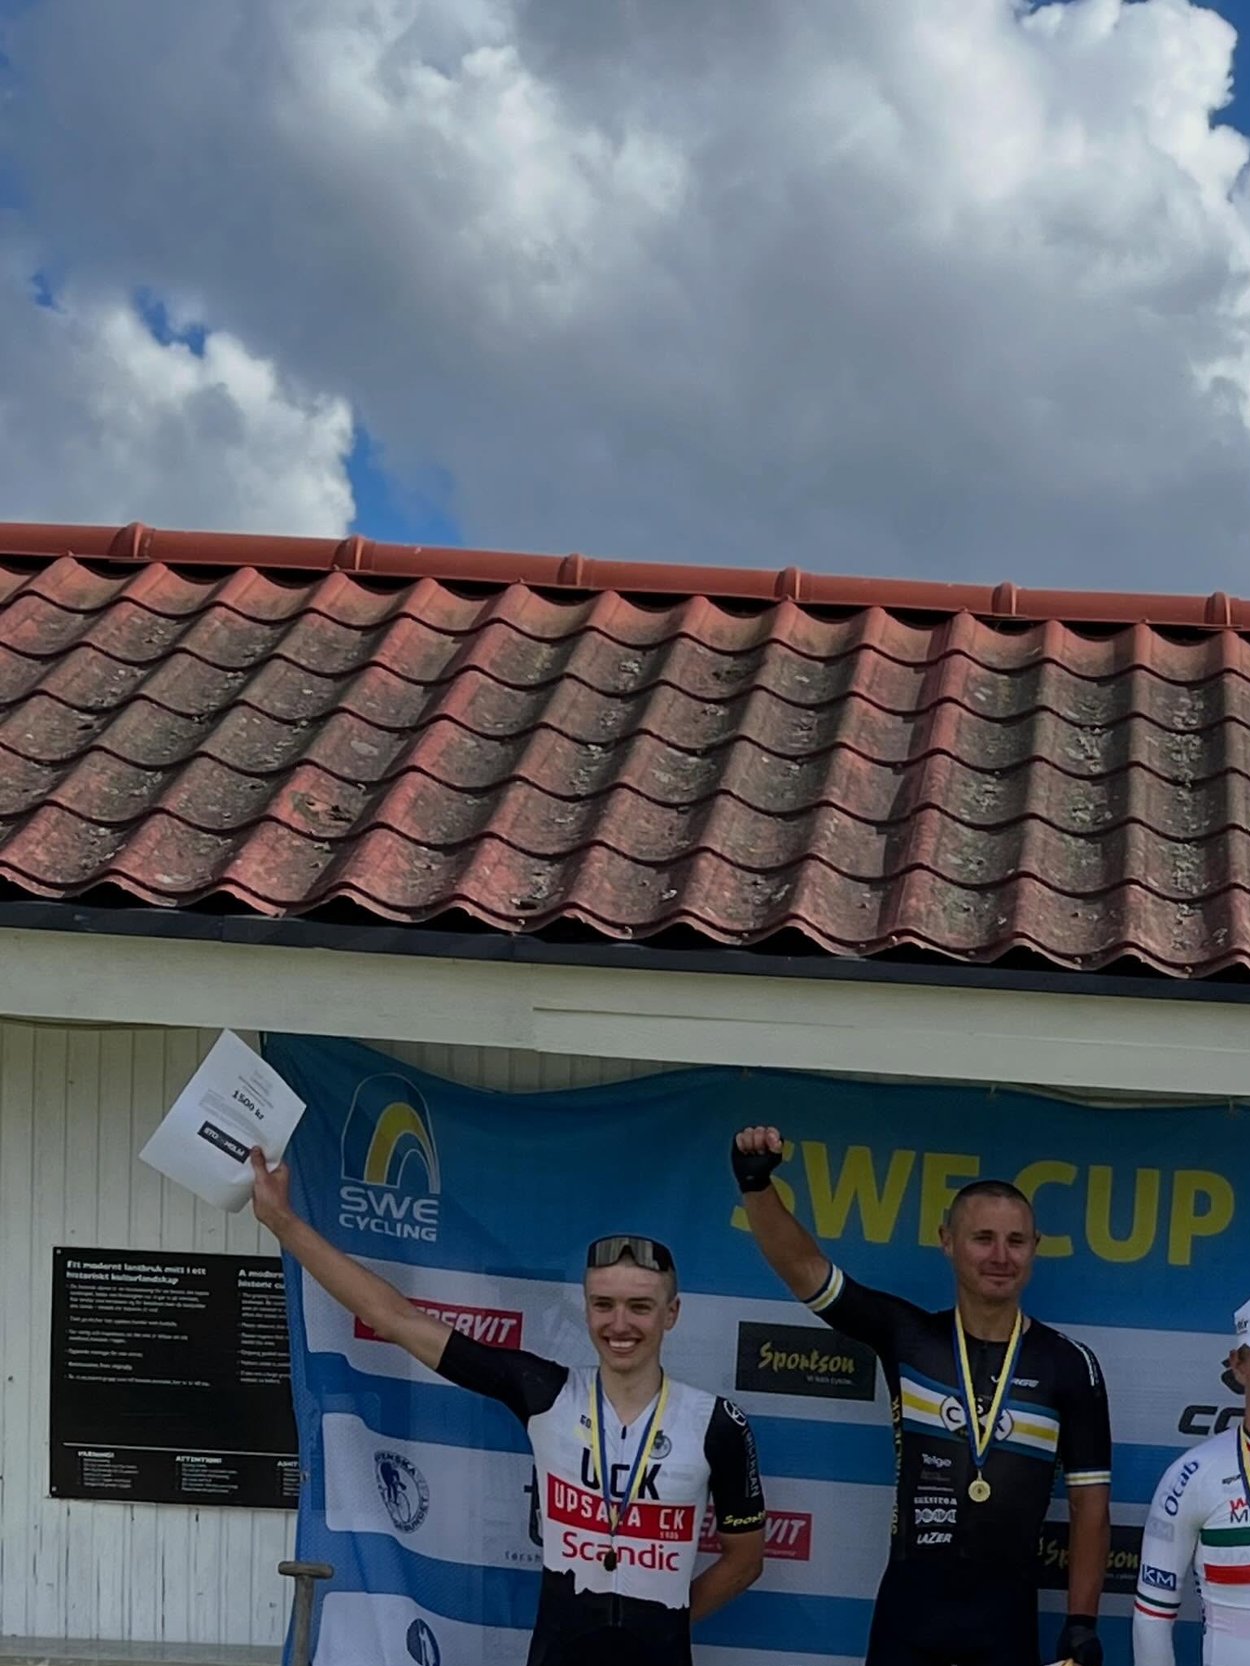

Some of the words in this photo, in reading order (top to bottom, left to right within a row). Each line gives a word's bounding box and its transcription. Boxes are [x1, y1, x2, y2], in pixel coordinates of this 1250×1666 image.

[339, 1186, 440, 1225] SWE
[1014, 1160, 1236, 1266] CUP
[338, 1212, 438, 1243] CYCLING
[758, 1340, 856, 1374] Sportson
[1177, 1405, 1246, 1436] CC
[580, 1447, 662, 1500] UCK
[1164, 1461, 1199, 1516] Ocab
[554, 1481, 642, 1528] UPSAA
[659, 1508, 686, 1530] CK
[561, 1531, 680, 1571] Scandic
[1143, 1568, 1176, 1588] KM
